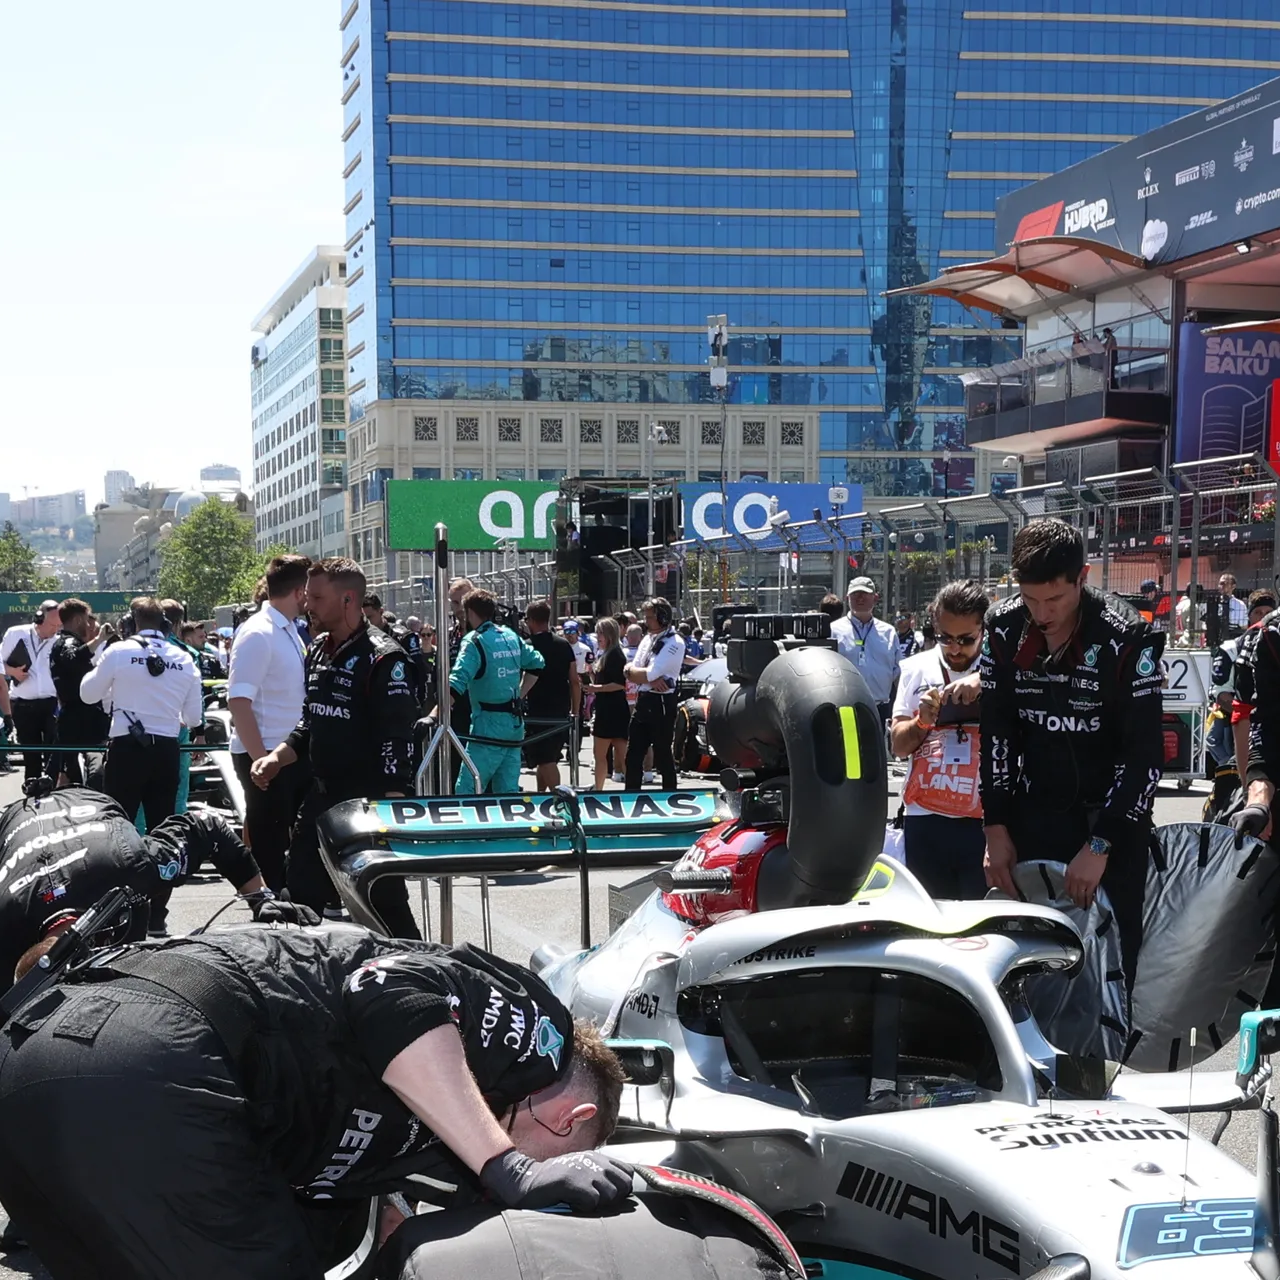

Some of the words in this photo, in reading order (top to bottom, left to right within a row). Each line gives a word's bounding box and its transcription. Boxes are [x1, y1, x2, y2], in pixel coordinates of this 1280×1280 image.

[1175, 165, 1200, 187] PIRELLI
[1137, 183, 1160, 200] ROLEX
[1064, 199, 1108, 234] HYBRID
[1204, 356, 1269, 376] BAKU
[479, 490, 773, 540] arco
[131, 656, 184, 672] PETNAS
[1071, 678, 1100, 691] INEOS
[308, 702, 351, 720] TRONAS
[1019, 708, 1101, 732] PETONAS
[918, 774, 974, 793] LANE
[390, 793, 703, 825] PETRONAS
[482, 986, 505, 1040] AMD
[504, 1003, 526, 1050] IWC
[974, 1117, 1176, 1135] PETRONAS
[992, 1126, 1189, 1151] Syntium
[893, 1184, 1021, 1276] AMG
